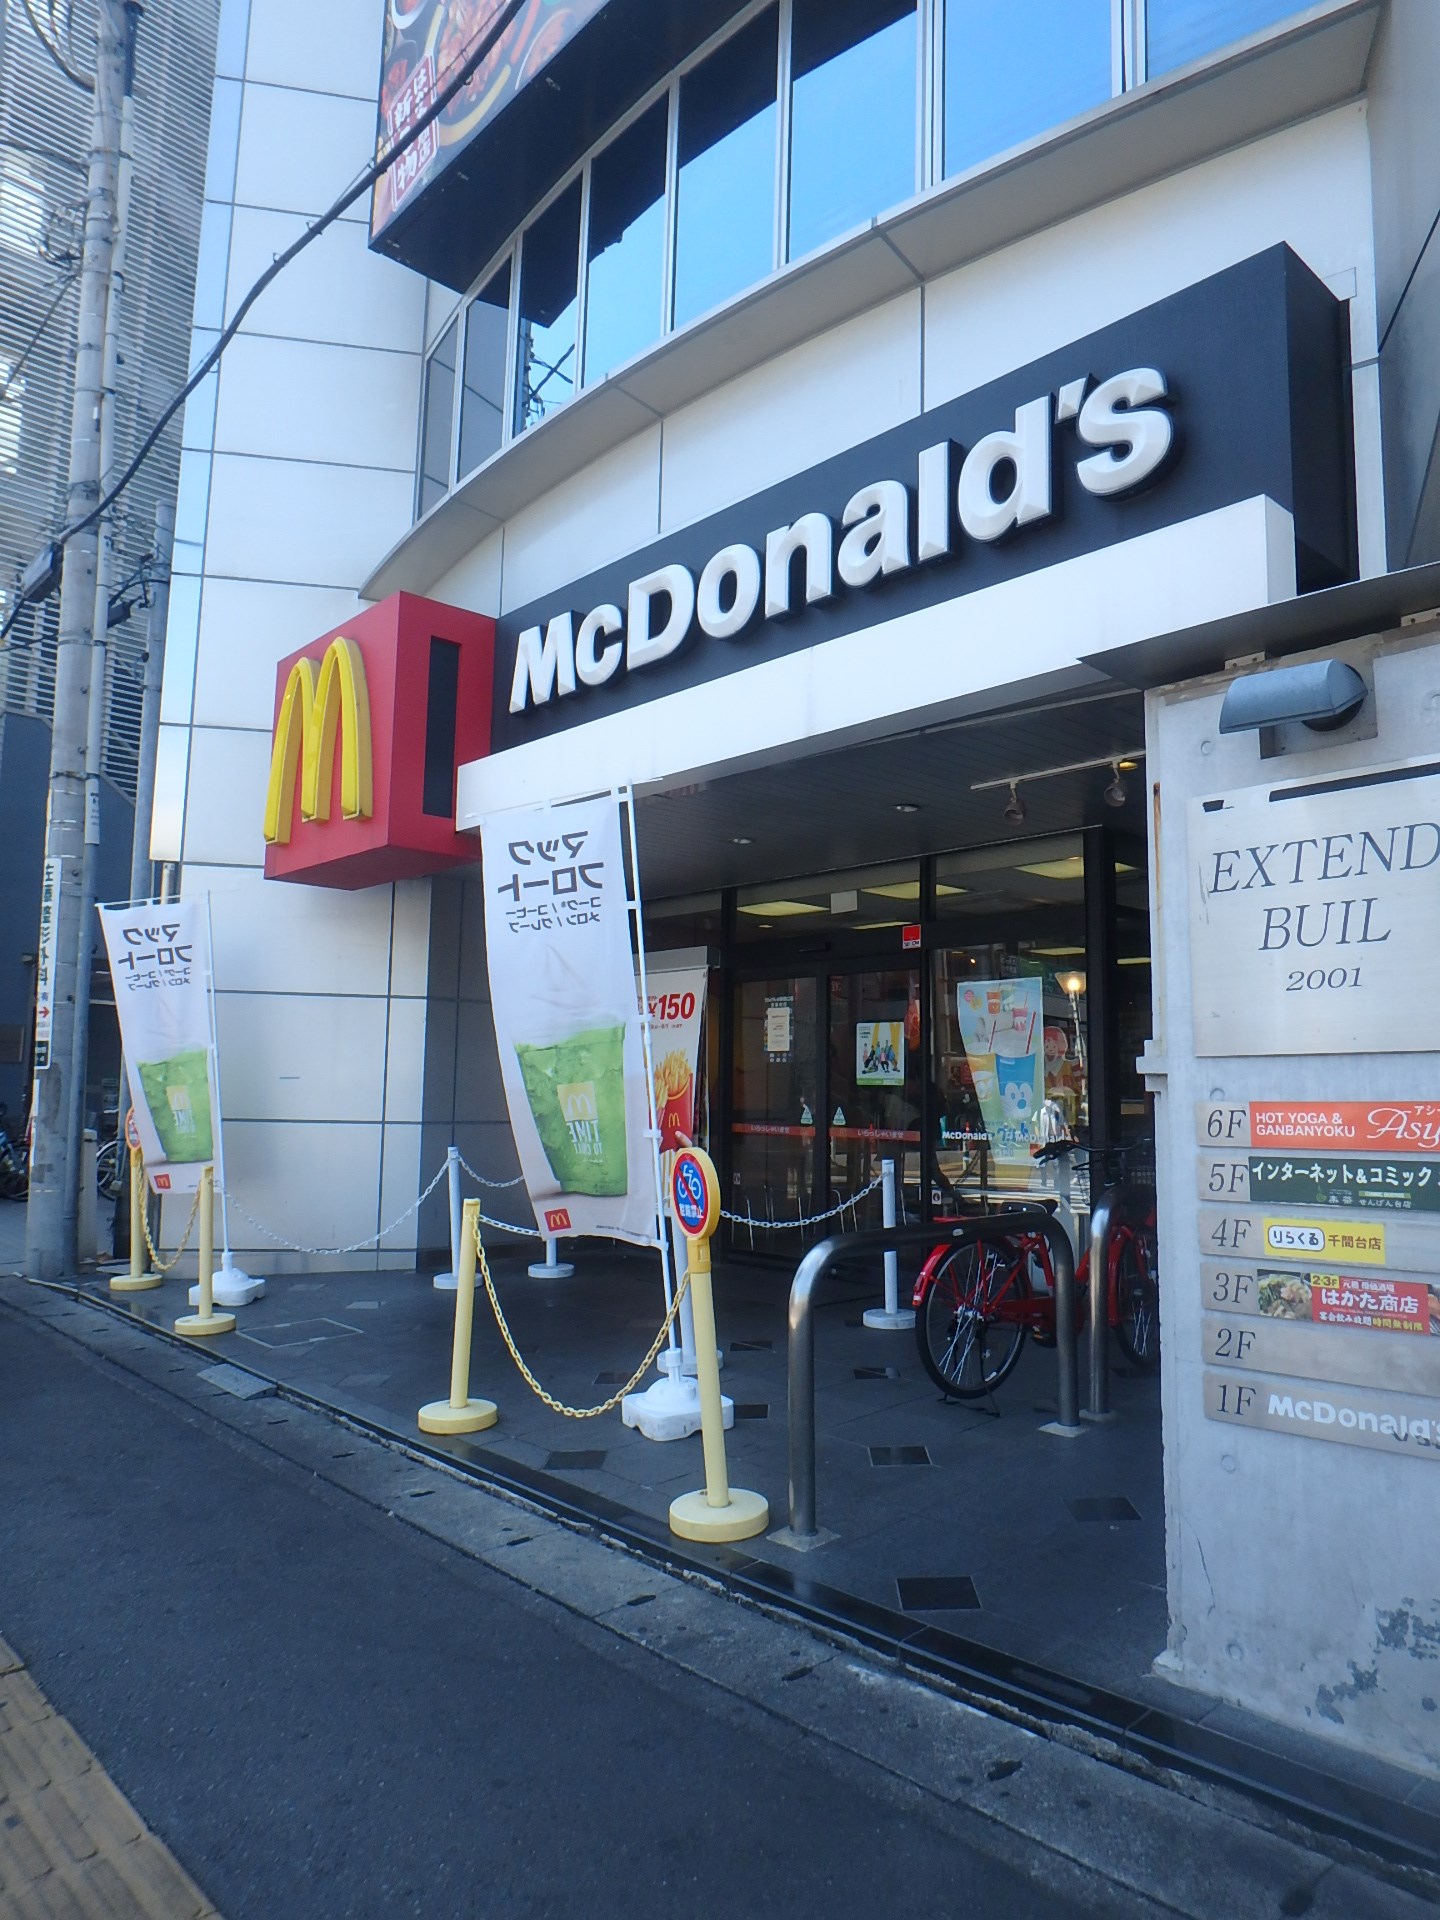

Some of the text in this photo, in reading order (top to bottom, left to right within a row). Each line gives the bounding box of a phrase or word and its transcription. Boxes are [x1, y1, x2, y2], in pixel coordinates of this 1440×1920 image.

[508, 367, 1174, 714] McDonald's
[1209, 822, 1440, 893] EXTEND
[1258, 898, 1392, 951] BUIL
[1285, 967, 1363, 992] 2001
[1207, 1109, 1247, 1138] 6F
[1256, 1112, 1343, 1124] HOT YOGA &
[1256, 1125, 1356, 1138] GANBANYOKU
[942, 1130, 993, 1141] McDonald's
[1209, 1163, 1249, 1192] 5F
[1211, 1218, 1252, 1248] 4F
[1273, 1229, 1382, 1250] りらくる 千間台店
[1213, 1273, 1254, 1303] 3F
[1321, 1288, 1419, 1314] はかた商店
[1215, 1328, 1256, 1359] 2F
[1217, 1384, 1258, 1415] 1F
[1268, 1394, 1440, 1440] McDonald'
